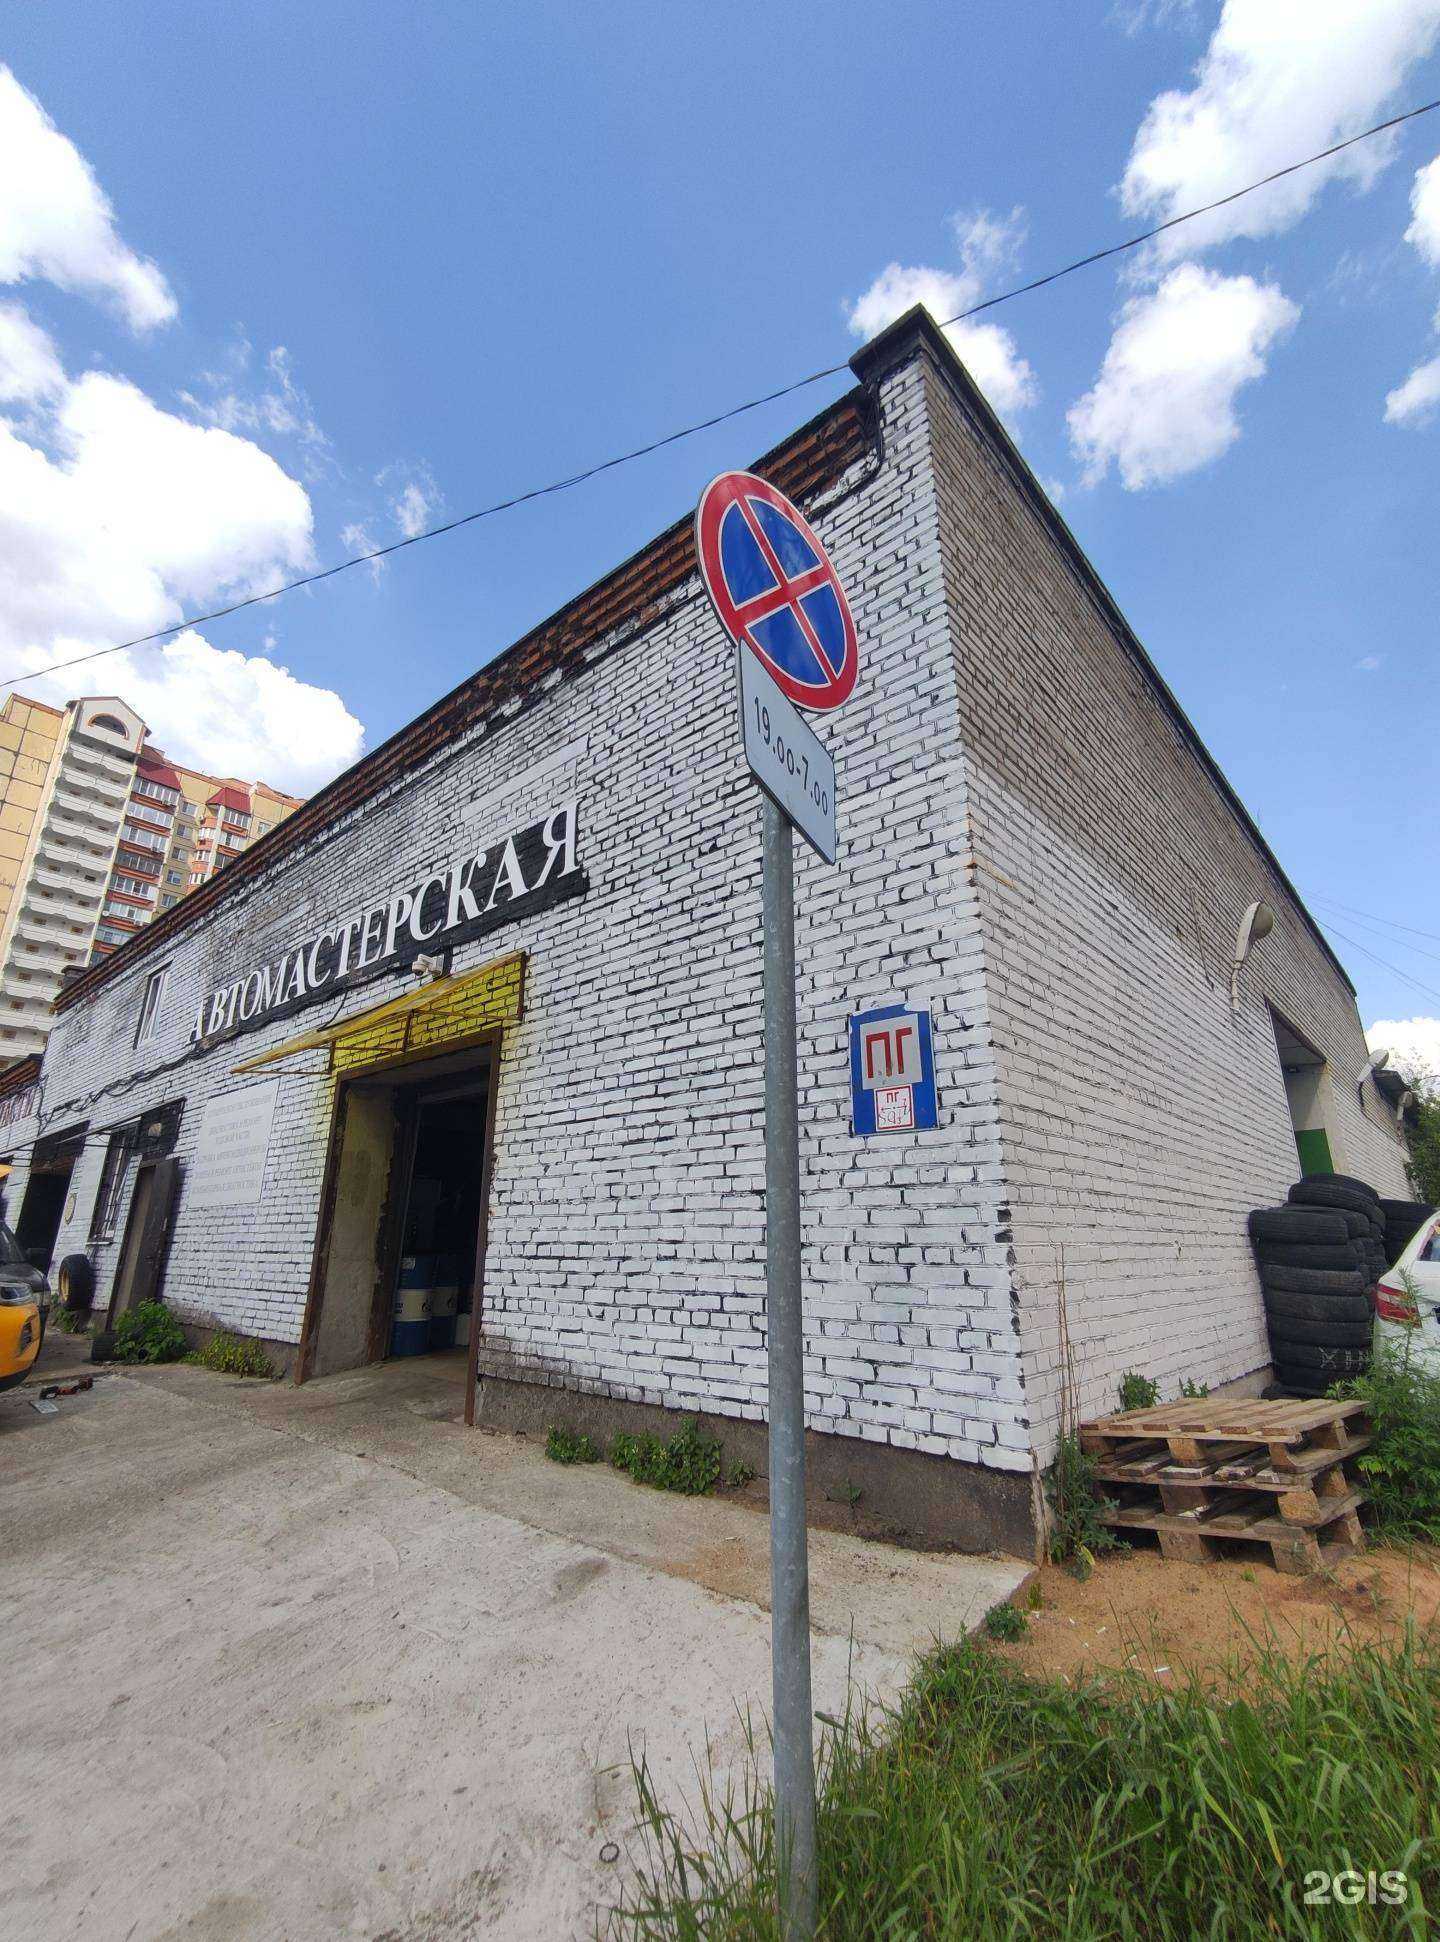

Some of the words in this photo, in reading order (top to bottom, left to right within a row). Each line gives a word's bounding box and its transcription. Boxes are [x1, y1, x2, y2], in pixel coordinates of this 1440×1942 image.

[755, 696, 828, 816] 19.00-7.00
[188, 802, 582, 1043] АВТОМАСТЕРСКАЯ
[865, 1027, 913, 1078] ПГ
